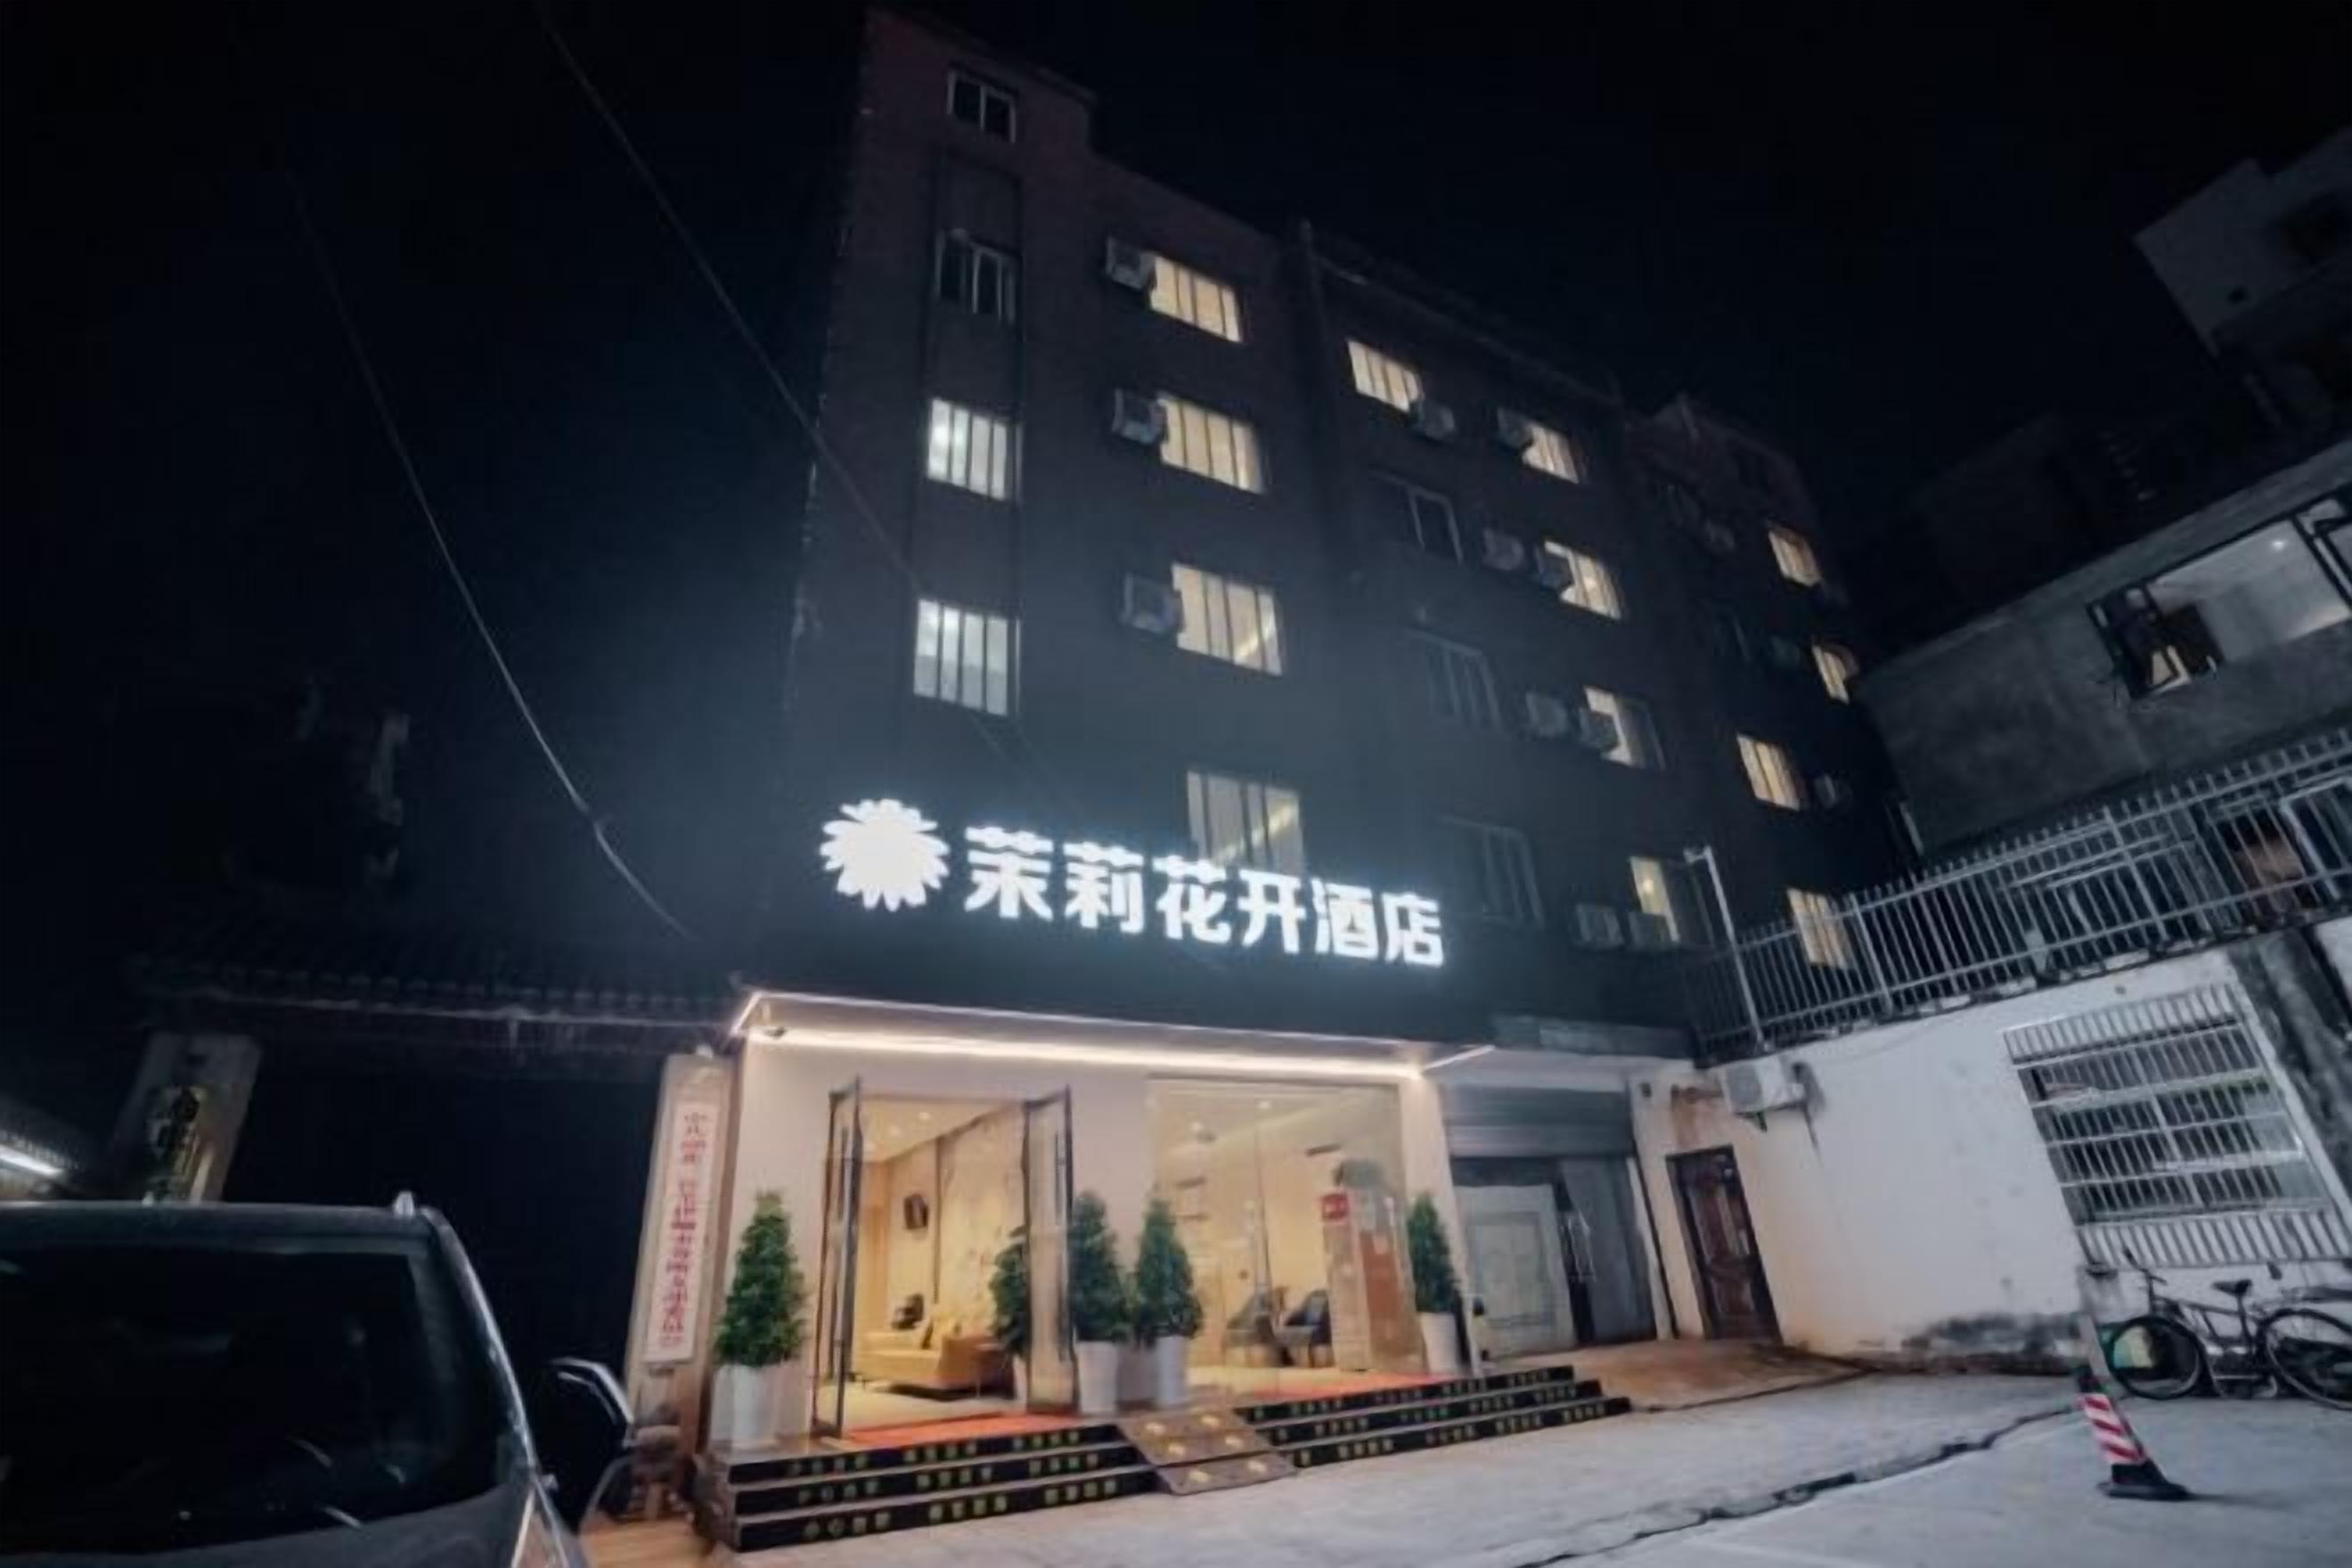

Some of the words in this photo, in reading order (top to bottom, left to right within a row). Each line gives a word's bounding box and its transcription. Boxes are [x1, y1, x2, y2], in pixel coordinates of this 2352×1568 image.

[965, 825, 1445, 968] 茉莉花开酒店
